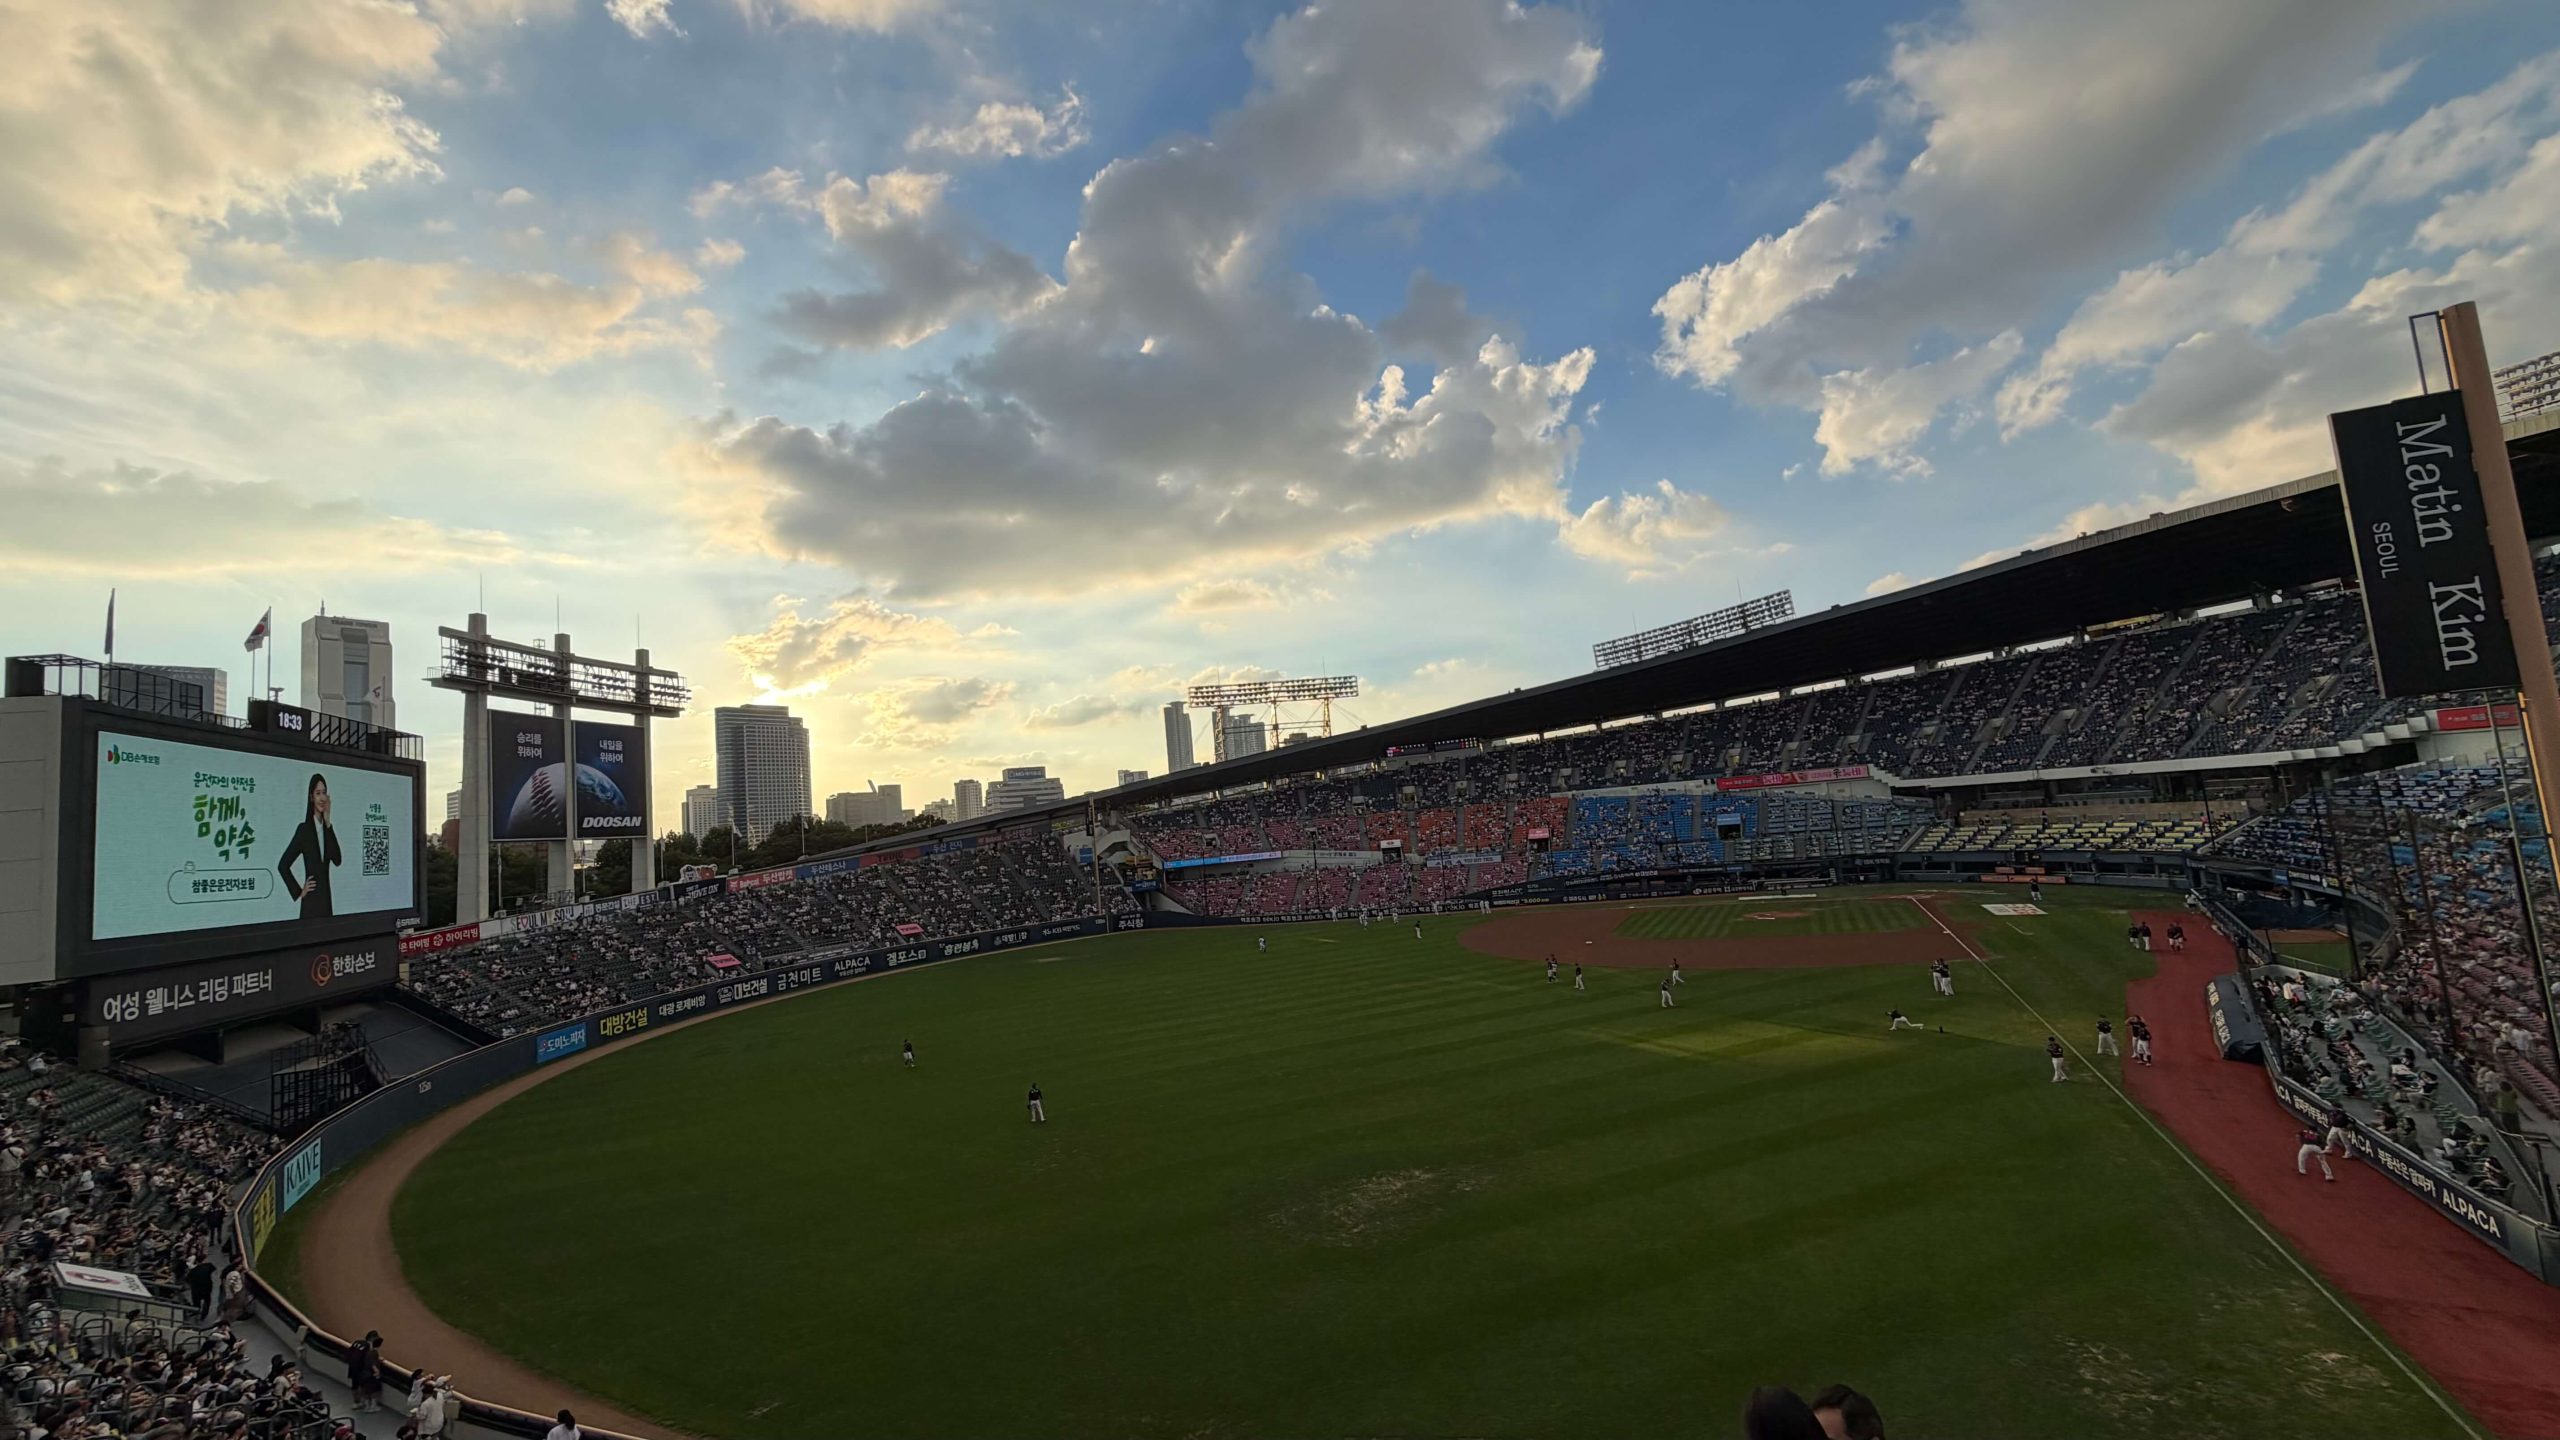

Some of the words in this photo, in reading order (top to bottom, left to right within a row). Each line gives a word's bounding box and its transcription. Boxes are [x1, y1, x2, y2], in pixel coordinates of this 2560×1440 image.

[2396, 414, 2463, 548] Matin
[2372, 521, 2400, 579] SEOUL
[2427, 575, 2486, 671] Kim
[278, 711, 303, 731] 18:33
[516, 731, 543, 745] 승리를
[599, 739, 624, 751] 내일을
[517, 745, 543, 759] 위하여
[599, 751, 624, 764] 위하여
[193, 771, 230, 789] 운전자의
[230, 776, 256, 794] 안전을
[582, 816, 642, 838] DOOSAN
[213, 821, 256, 863] 약속
[762, 869, 793, 884] 두산밥캣
[810, 861, 846, 875] 두산테스나
[191, 877, 256, 894] 참좋은운전자보험
[1118, 918, 1145, 930] 주식창
[408, 937, 430, 951] 타이밍
[445, 927, 479, 943] 하이리빙
[332, 951, 376, 977] 한화손보
[834, 955, 871, 972] ALPACA
[734, 977, 768, 1001] 대보건설
[777, 967, 823, 991] 금천미트
[103, 991, 140, 1023] 여성
[145, 984, 196, 1016] 웰니스
[198, 975, 229, 1003] 리딩
[231, 968, 272, 996] 파트너
[658, 999, 676, 1017] 대광
[675, 993, 706, 1013] 로제비앙
[600, 1006, 649, 1037] 대방건설
[546, 1028, 586, 1053] 도미노피자
[2442, 1187, 2502, 1239] ALPACA
